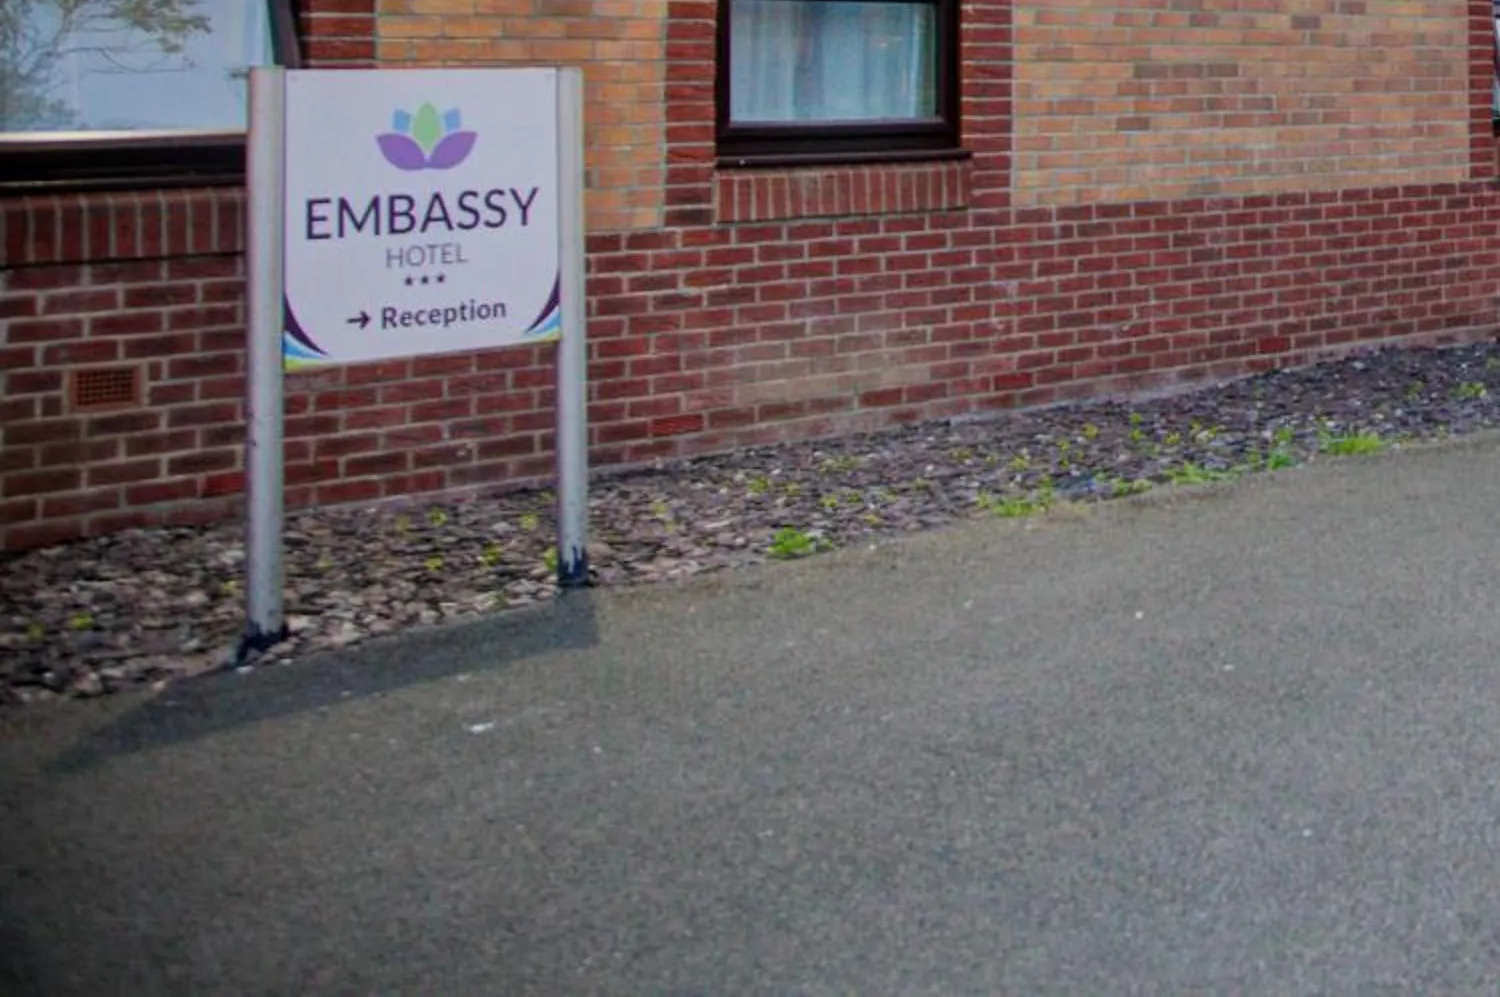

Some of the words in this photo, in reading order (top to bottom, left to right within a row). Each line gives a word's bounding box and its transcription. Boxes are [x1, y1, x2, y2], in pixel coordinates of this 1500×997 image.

[305, 187, 540, 241] EMBASSY
[385, 243, 469, 269] HOTEL
[380, 299, 507, 330] Reception
